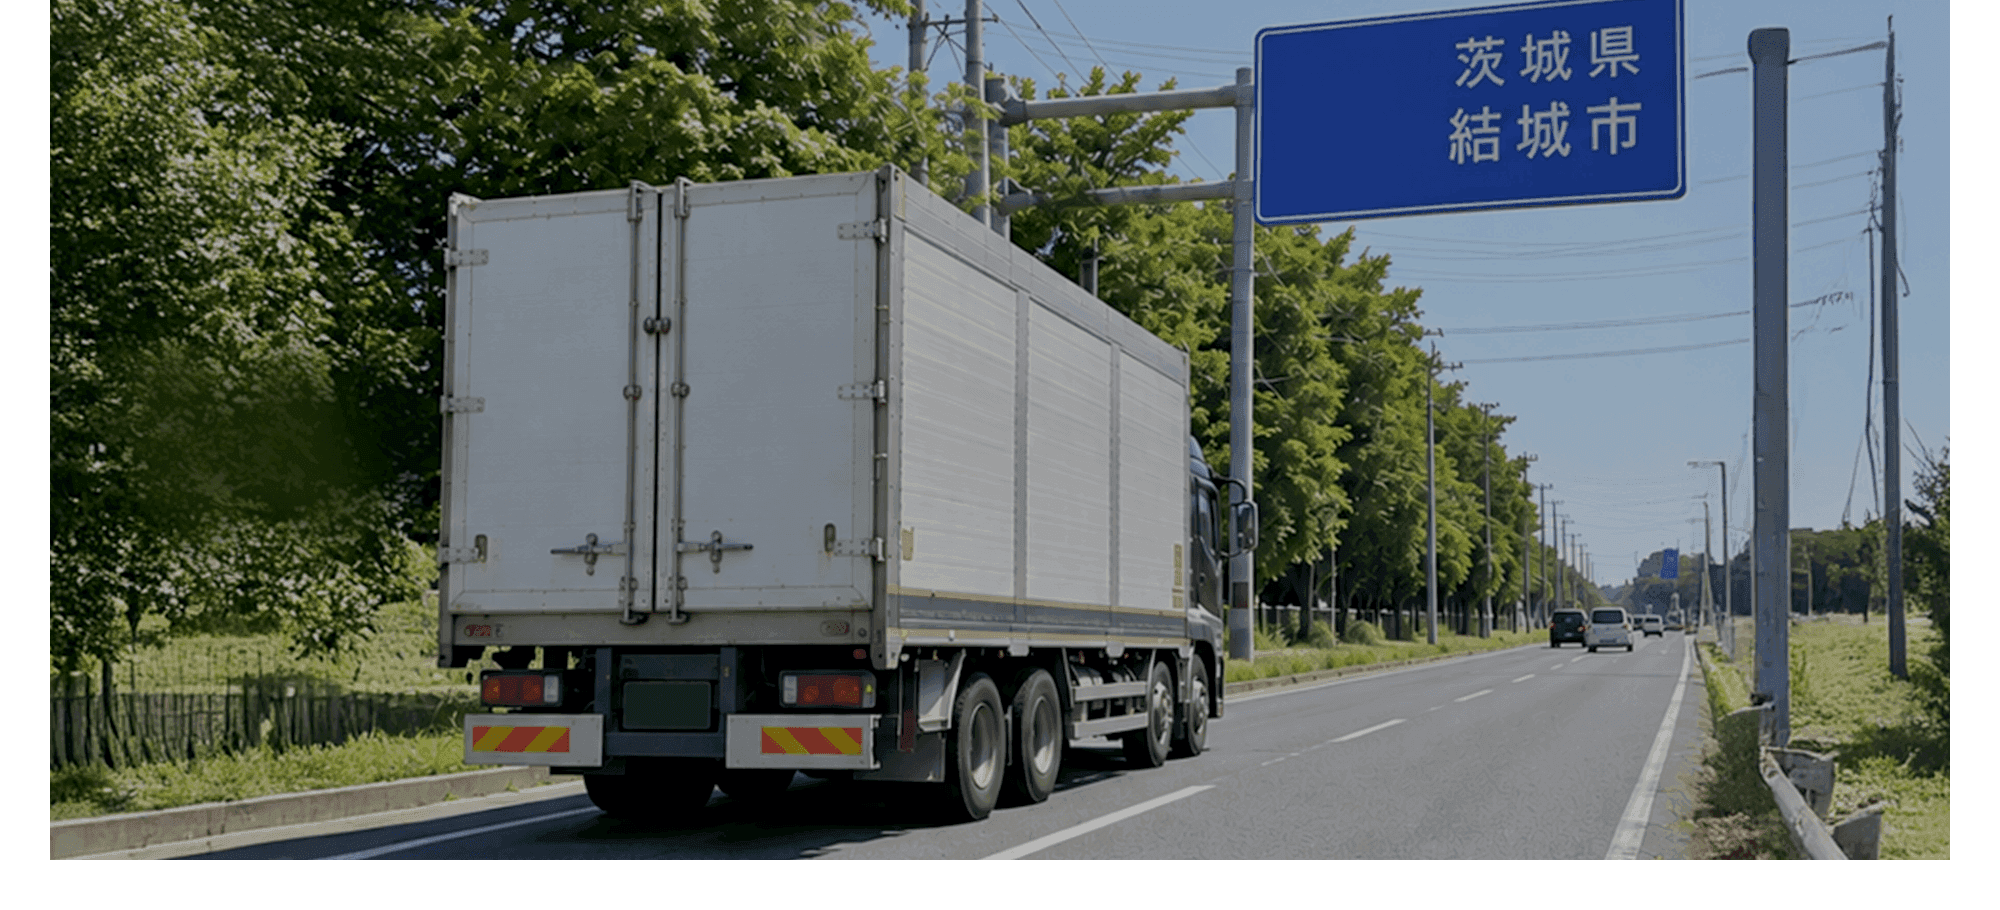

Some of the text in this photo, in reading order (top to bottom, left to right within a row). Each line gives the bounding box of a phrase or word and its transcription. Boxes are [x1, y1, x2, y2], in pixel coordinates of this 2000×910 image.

[1455, 26, 1640, 88] 茨城県
[1449, 97, 1642, 164] 結城市
